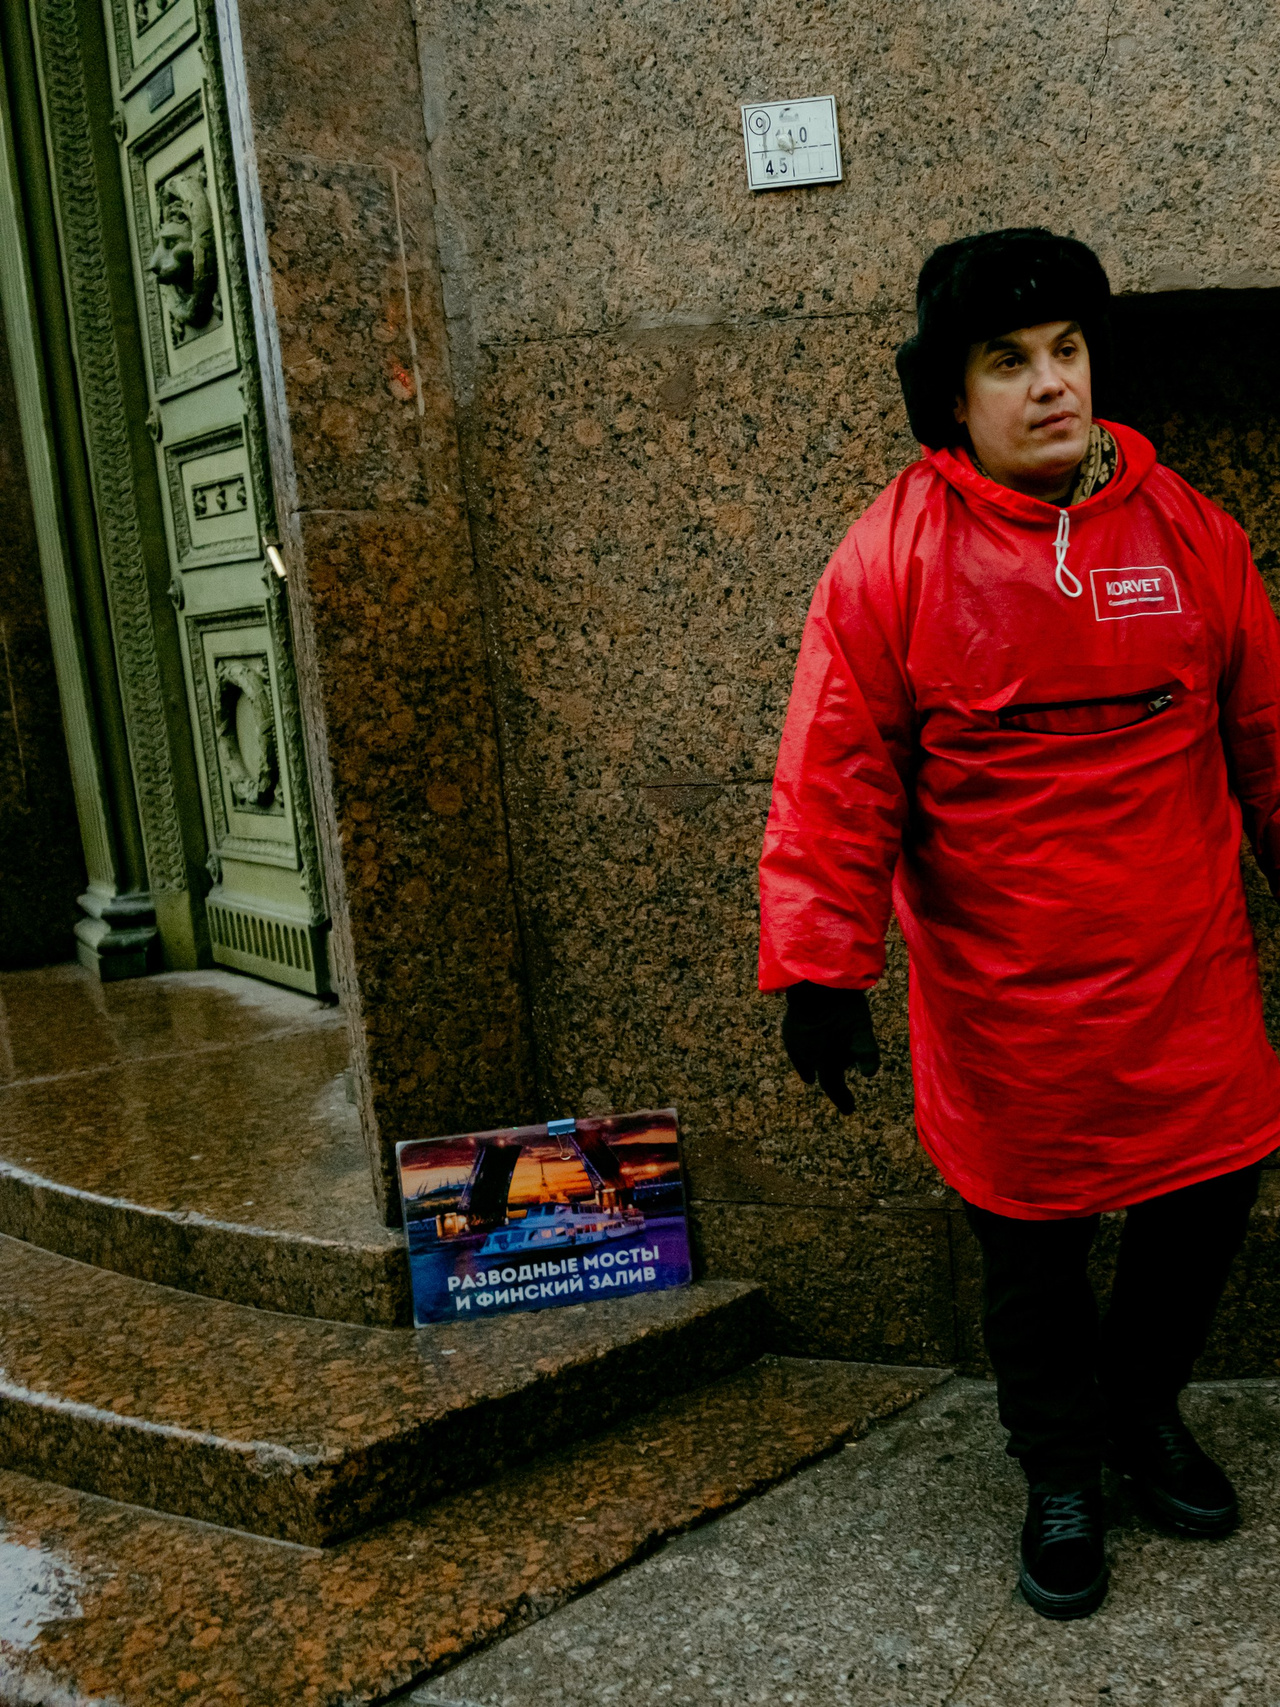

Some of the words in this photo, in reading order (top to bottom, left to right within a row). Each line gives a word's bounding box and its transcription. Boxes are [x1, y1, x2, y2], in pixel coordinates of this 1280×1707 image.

[447, 1258, 578, 1291] РАЗВОДНЫЕ
[583, 1245, 660, 1271] МОСТЫ
[455, 1295, 471, 1311] И
[475, 1275, 584, 1307] ФИНСКИЙ
[588, 1267, 656, 1290] ЗАЛИВ
